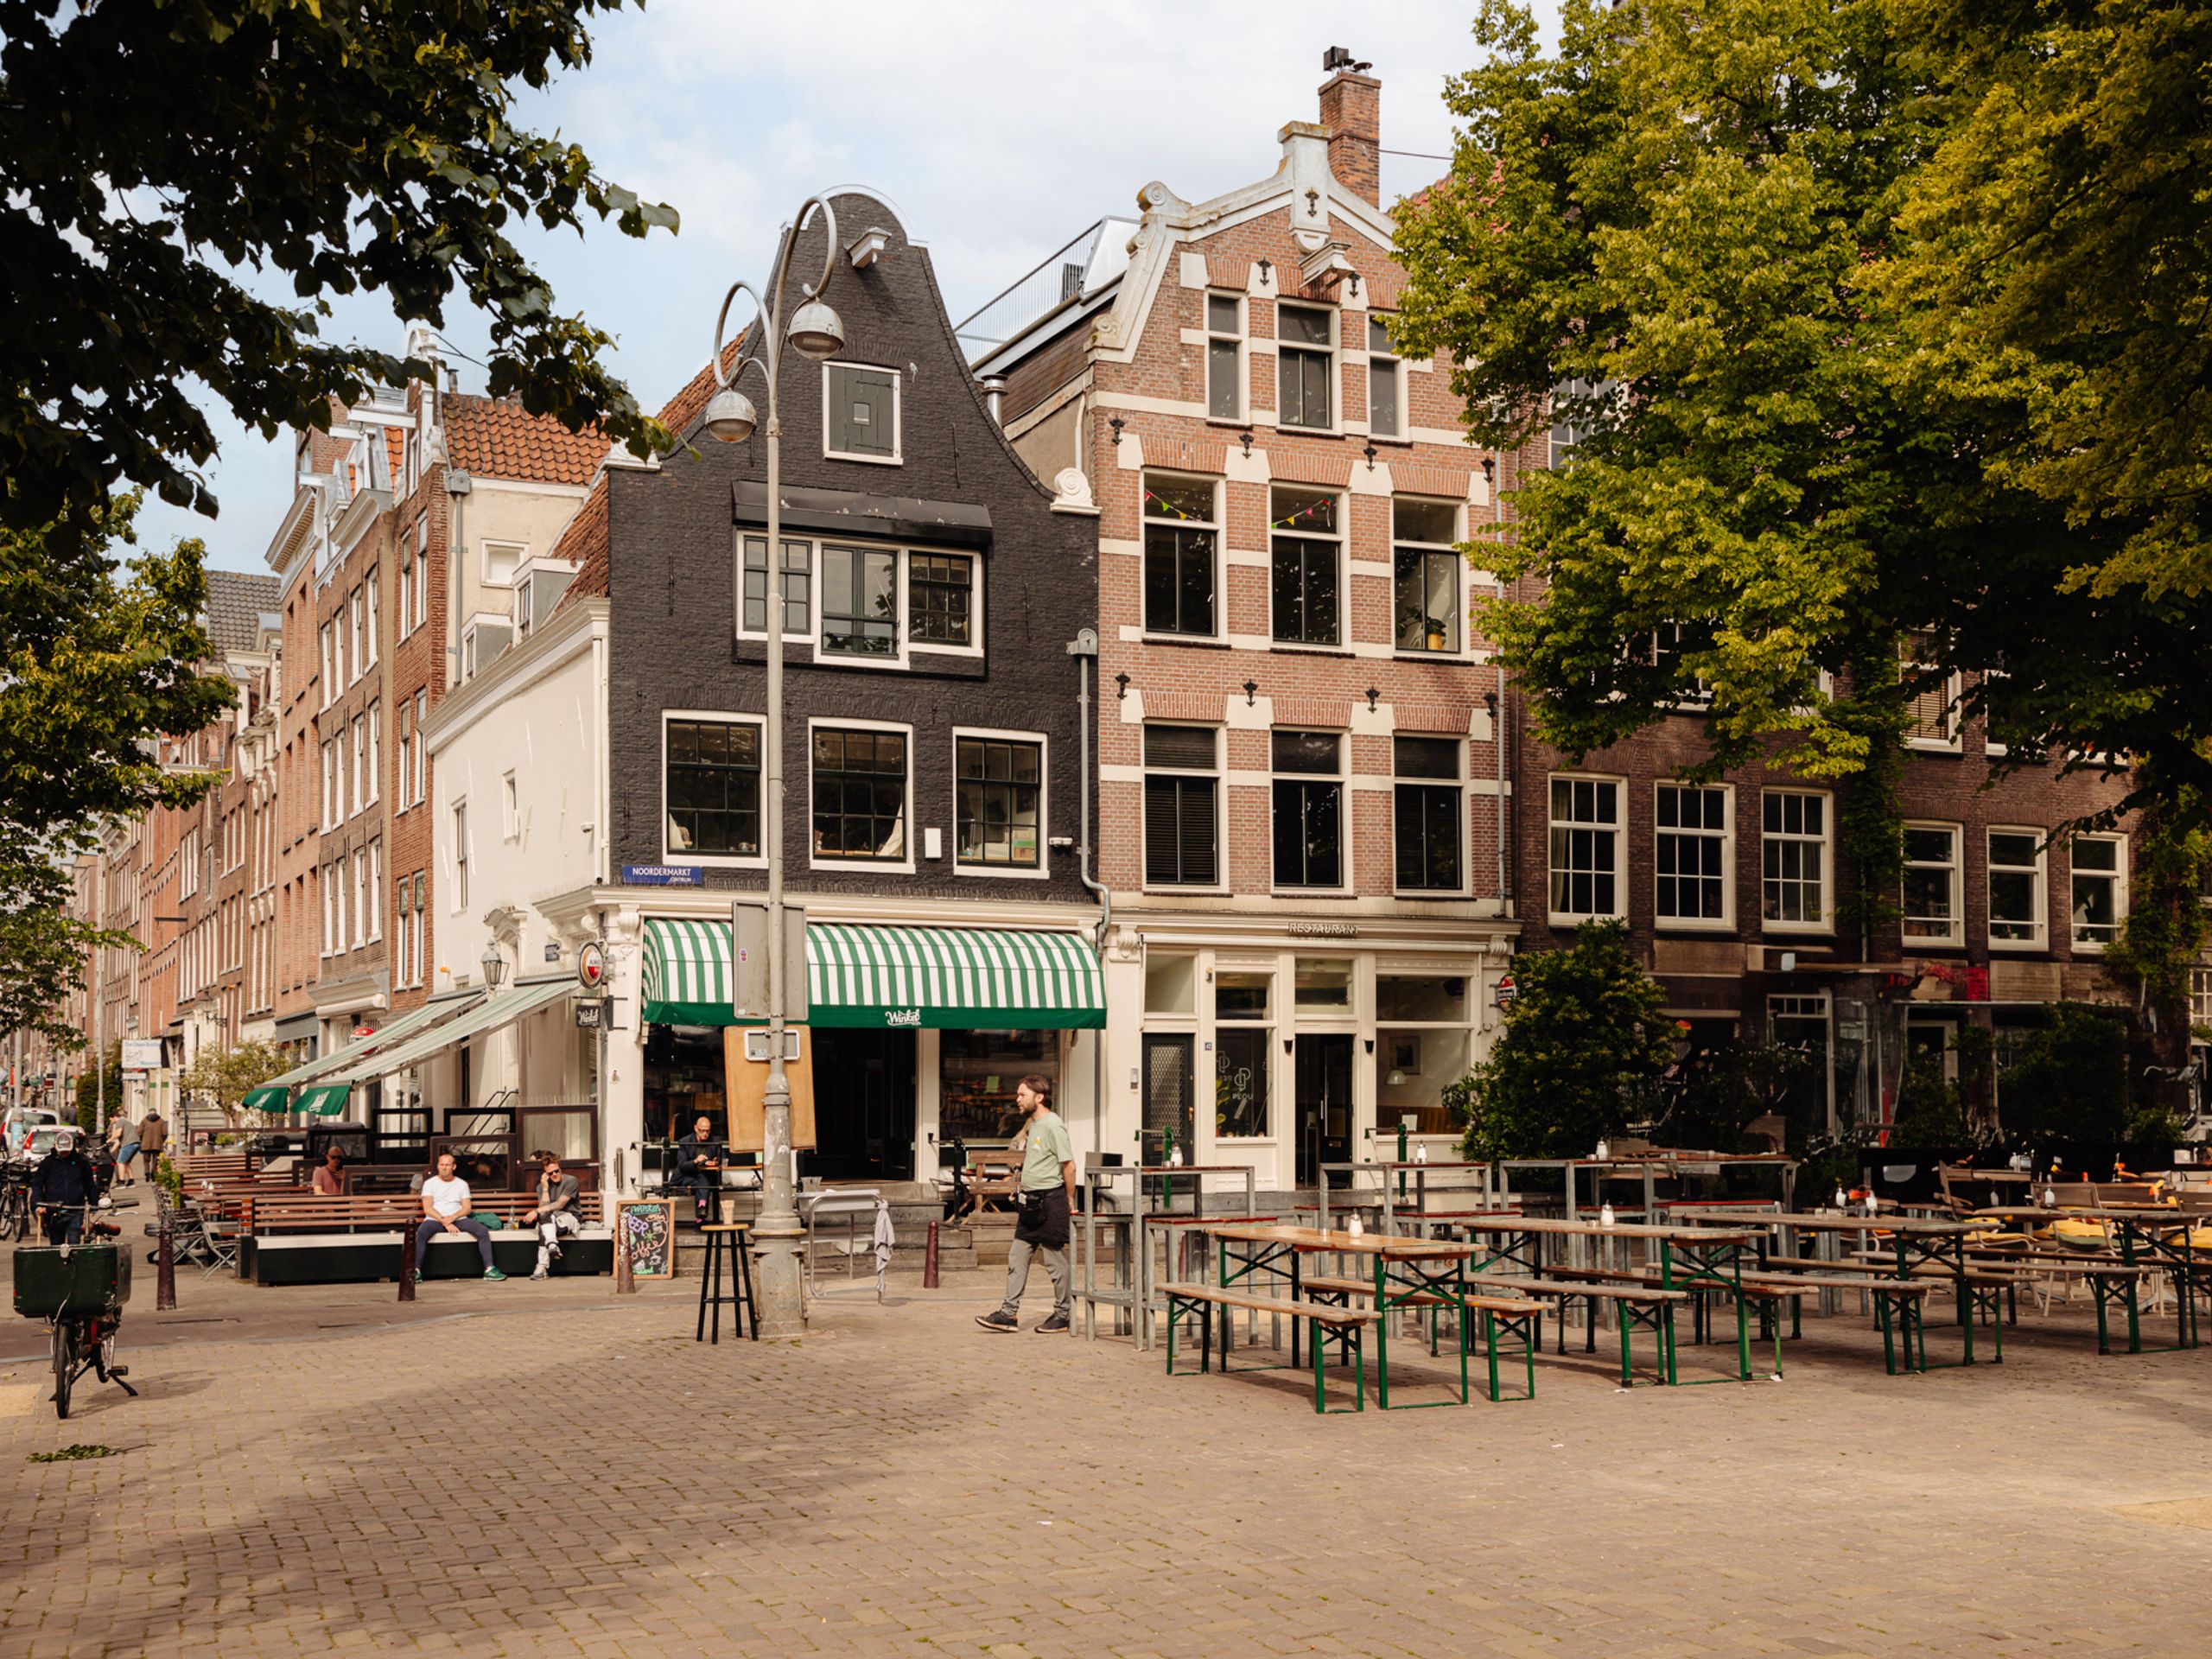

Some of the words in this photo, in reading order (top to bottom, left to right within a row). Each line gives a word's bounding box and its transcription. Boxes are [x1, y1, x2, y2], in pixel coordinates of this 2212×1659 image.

[632, 868, 691, 876] NOORDERMARKT
[1288, 922, 1358, 934] RESTAURANT
[885, 1008, 921, 1026] Winkel
[627, 1216, 649, 1237] EER
